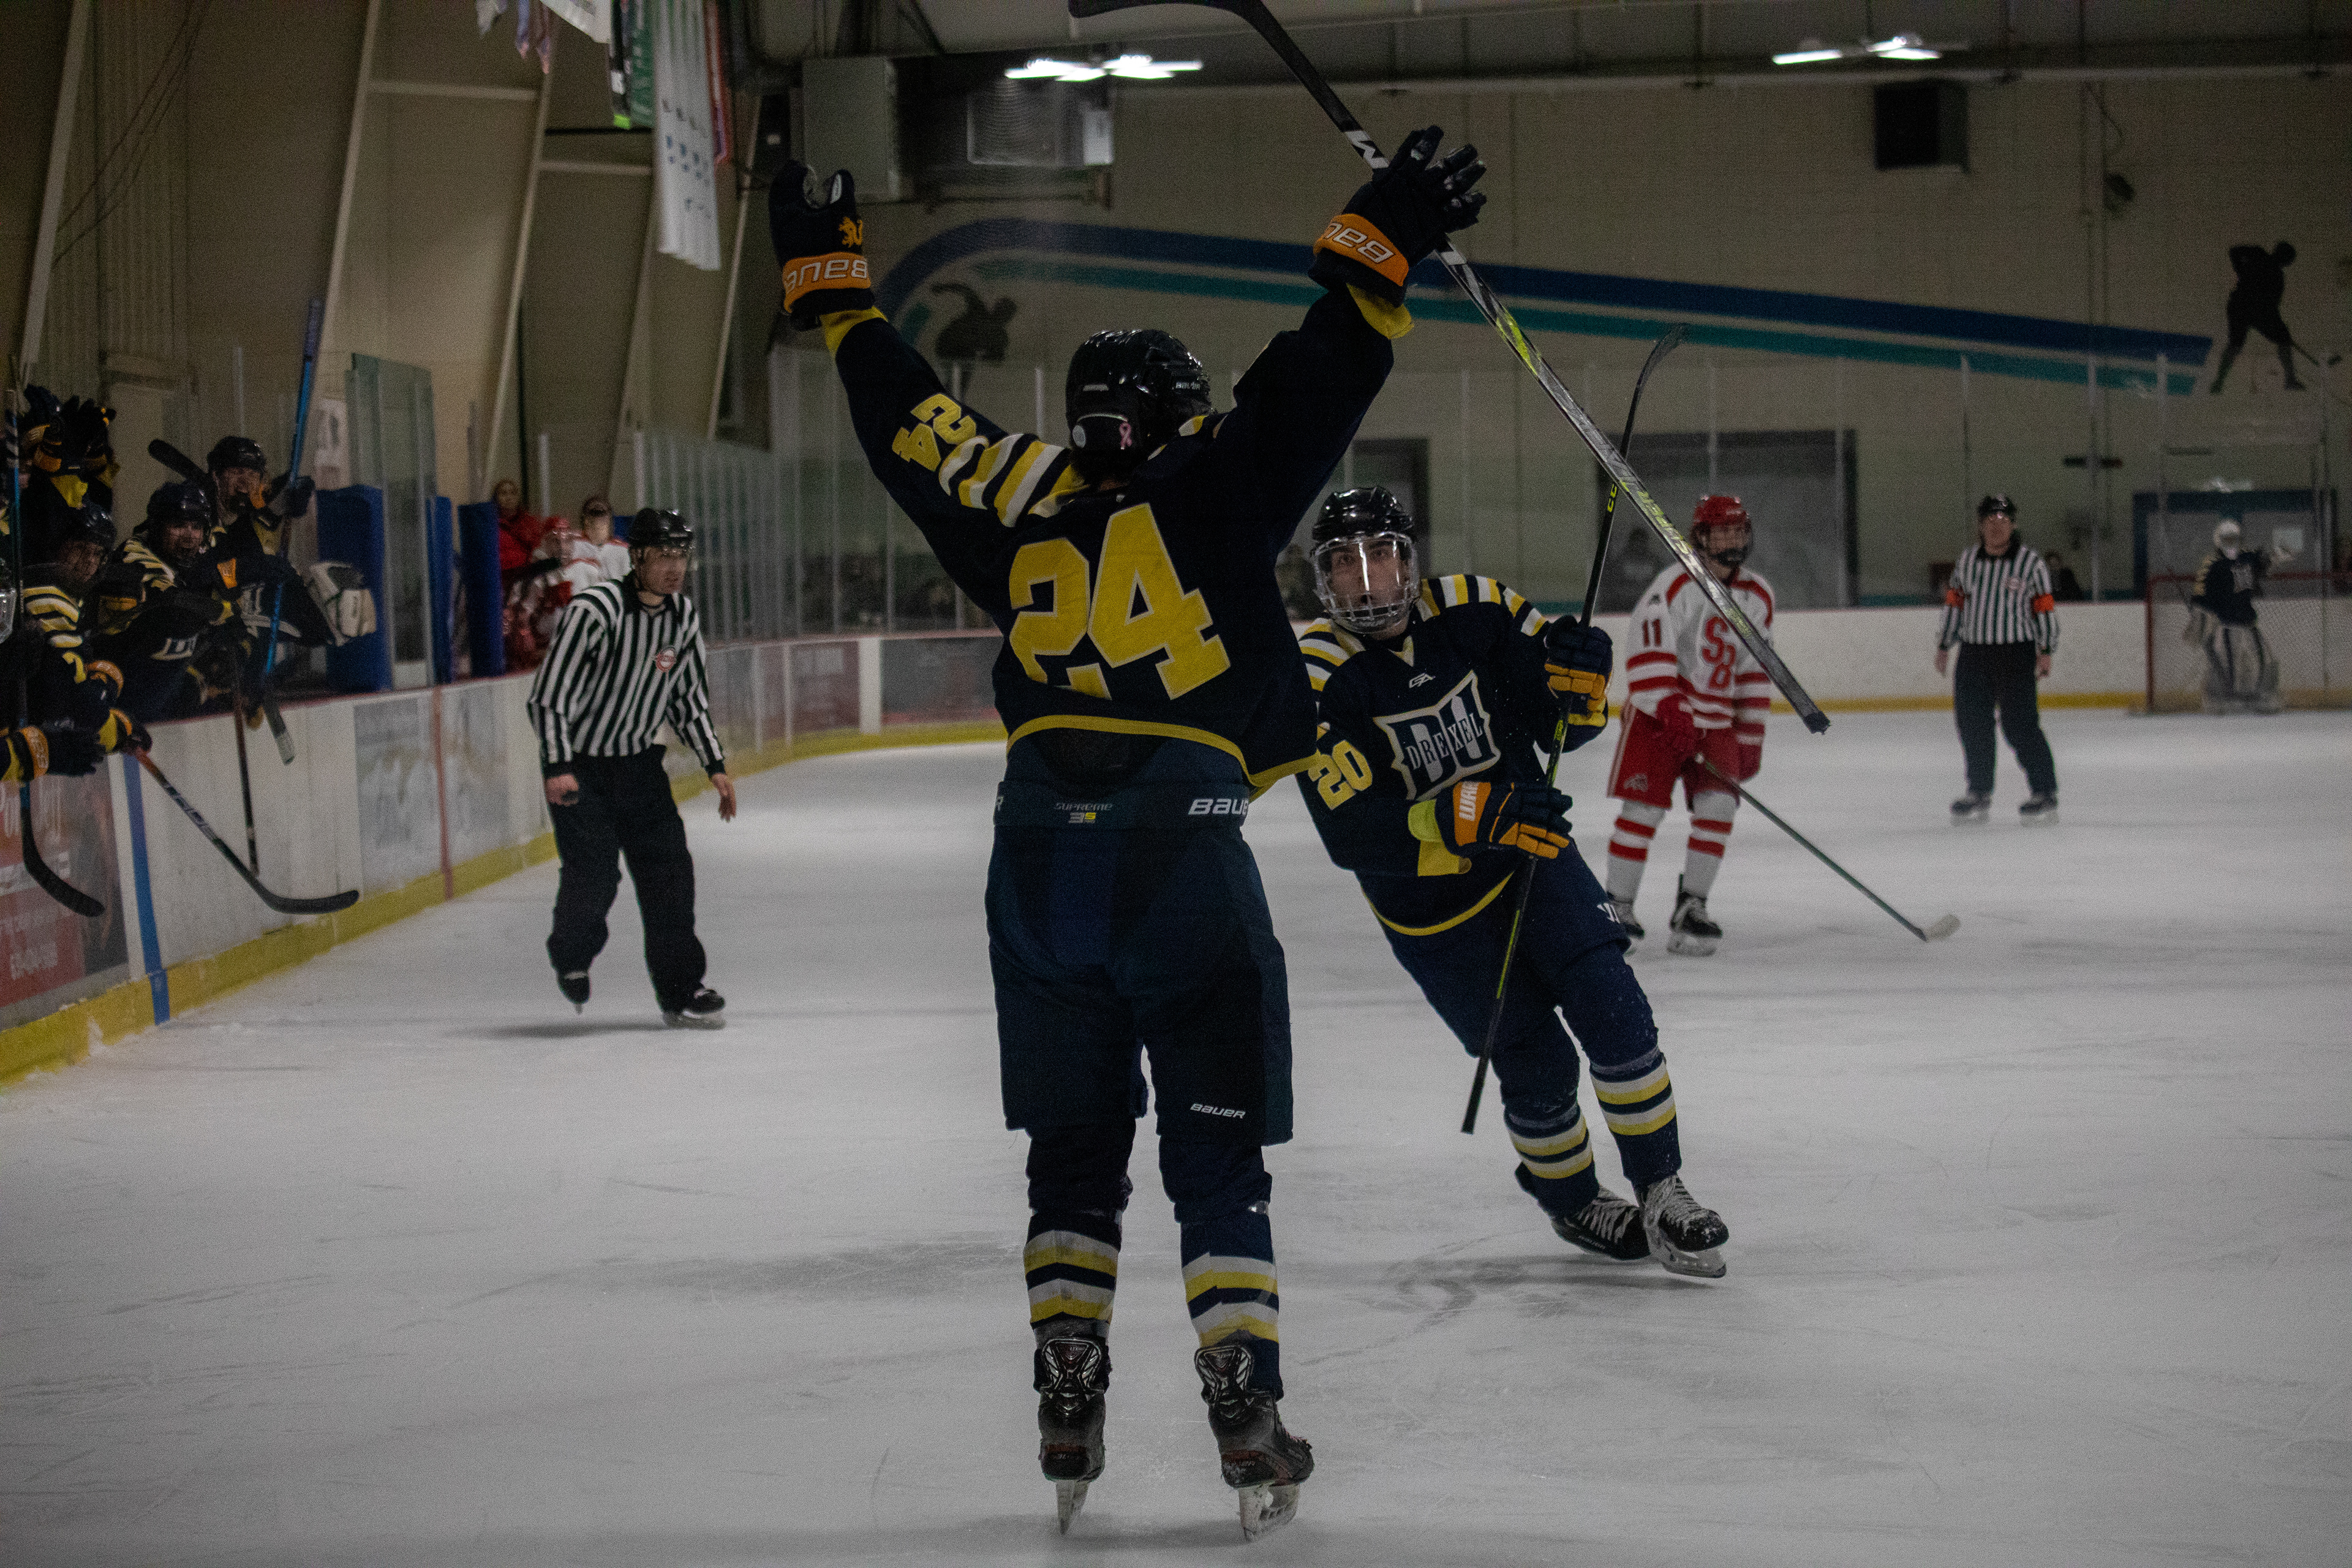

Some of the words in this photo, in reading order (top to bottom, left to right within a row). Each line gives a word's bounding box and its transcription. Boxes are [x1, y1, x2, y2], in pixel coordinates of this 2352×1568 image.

[1325, 222, 1394, 264] BAU
[784, 258, 869, 296] BAUE
[891, 392, 978, 473] 24
[1607, 483, 1618, 513] CC
[1008, 502, 1232, 701] 24
[1643, 618, 1662, 647] 11
[1405, 712, 1484, 771] DREXEL
[1307, 739, 1373, 811] 20
[1188, 797, 1249, 815] BAUE
[1189, 1102, 1246, 1120] BAUER
